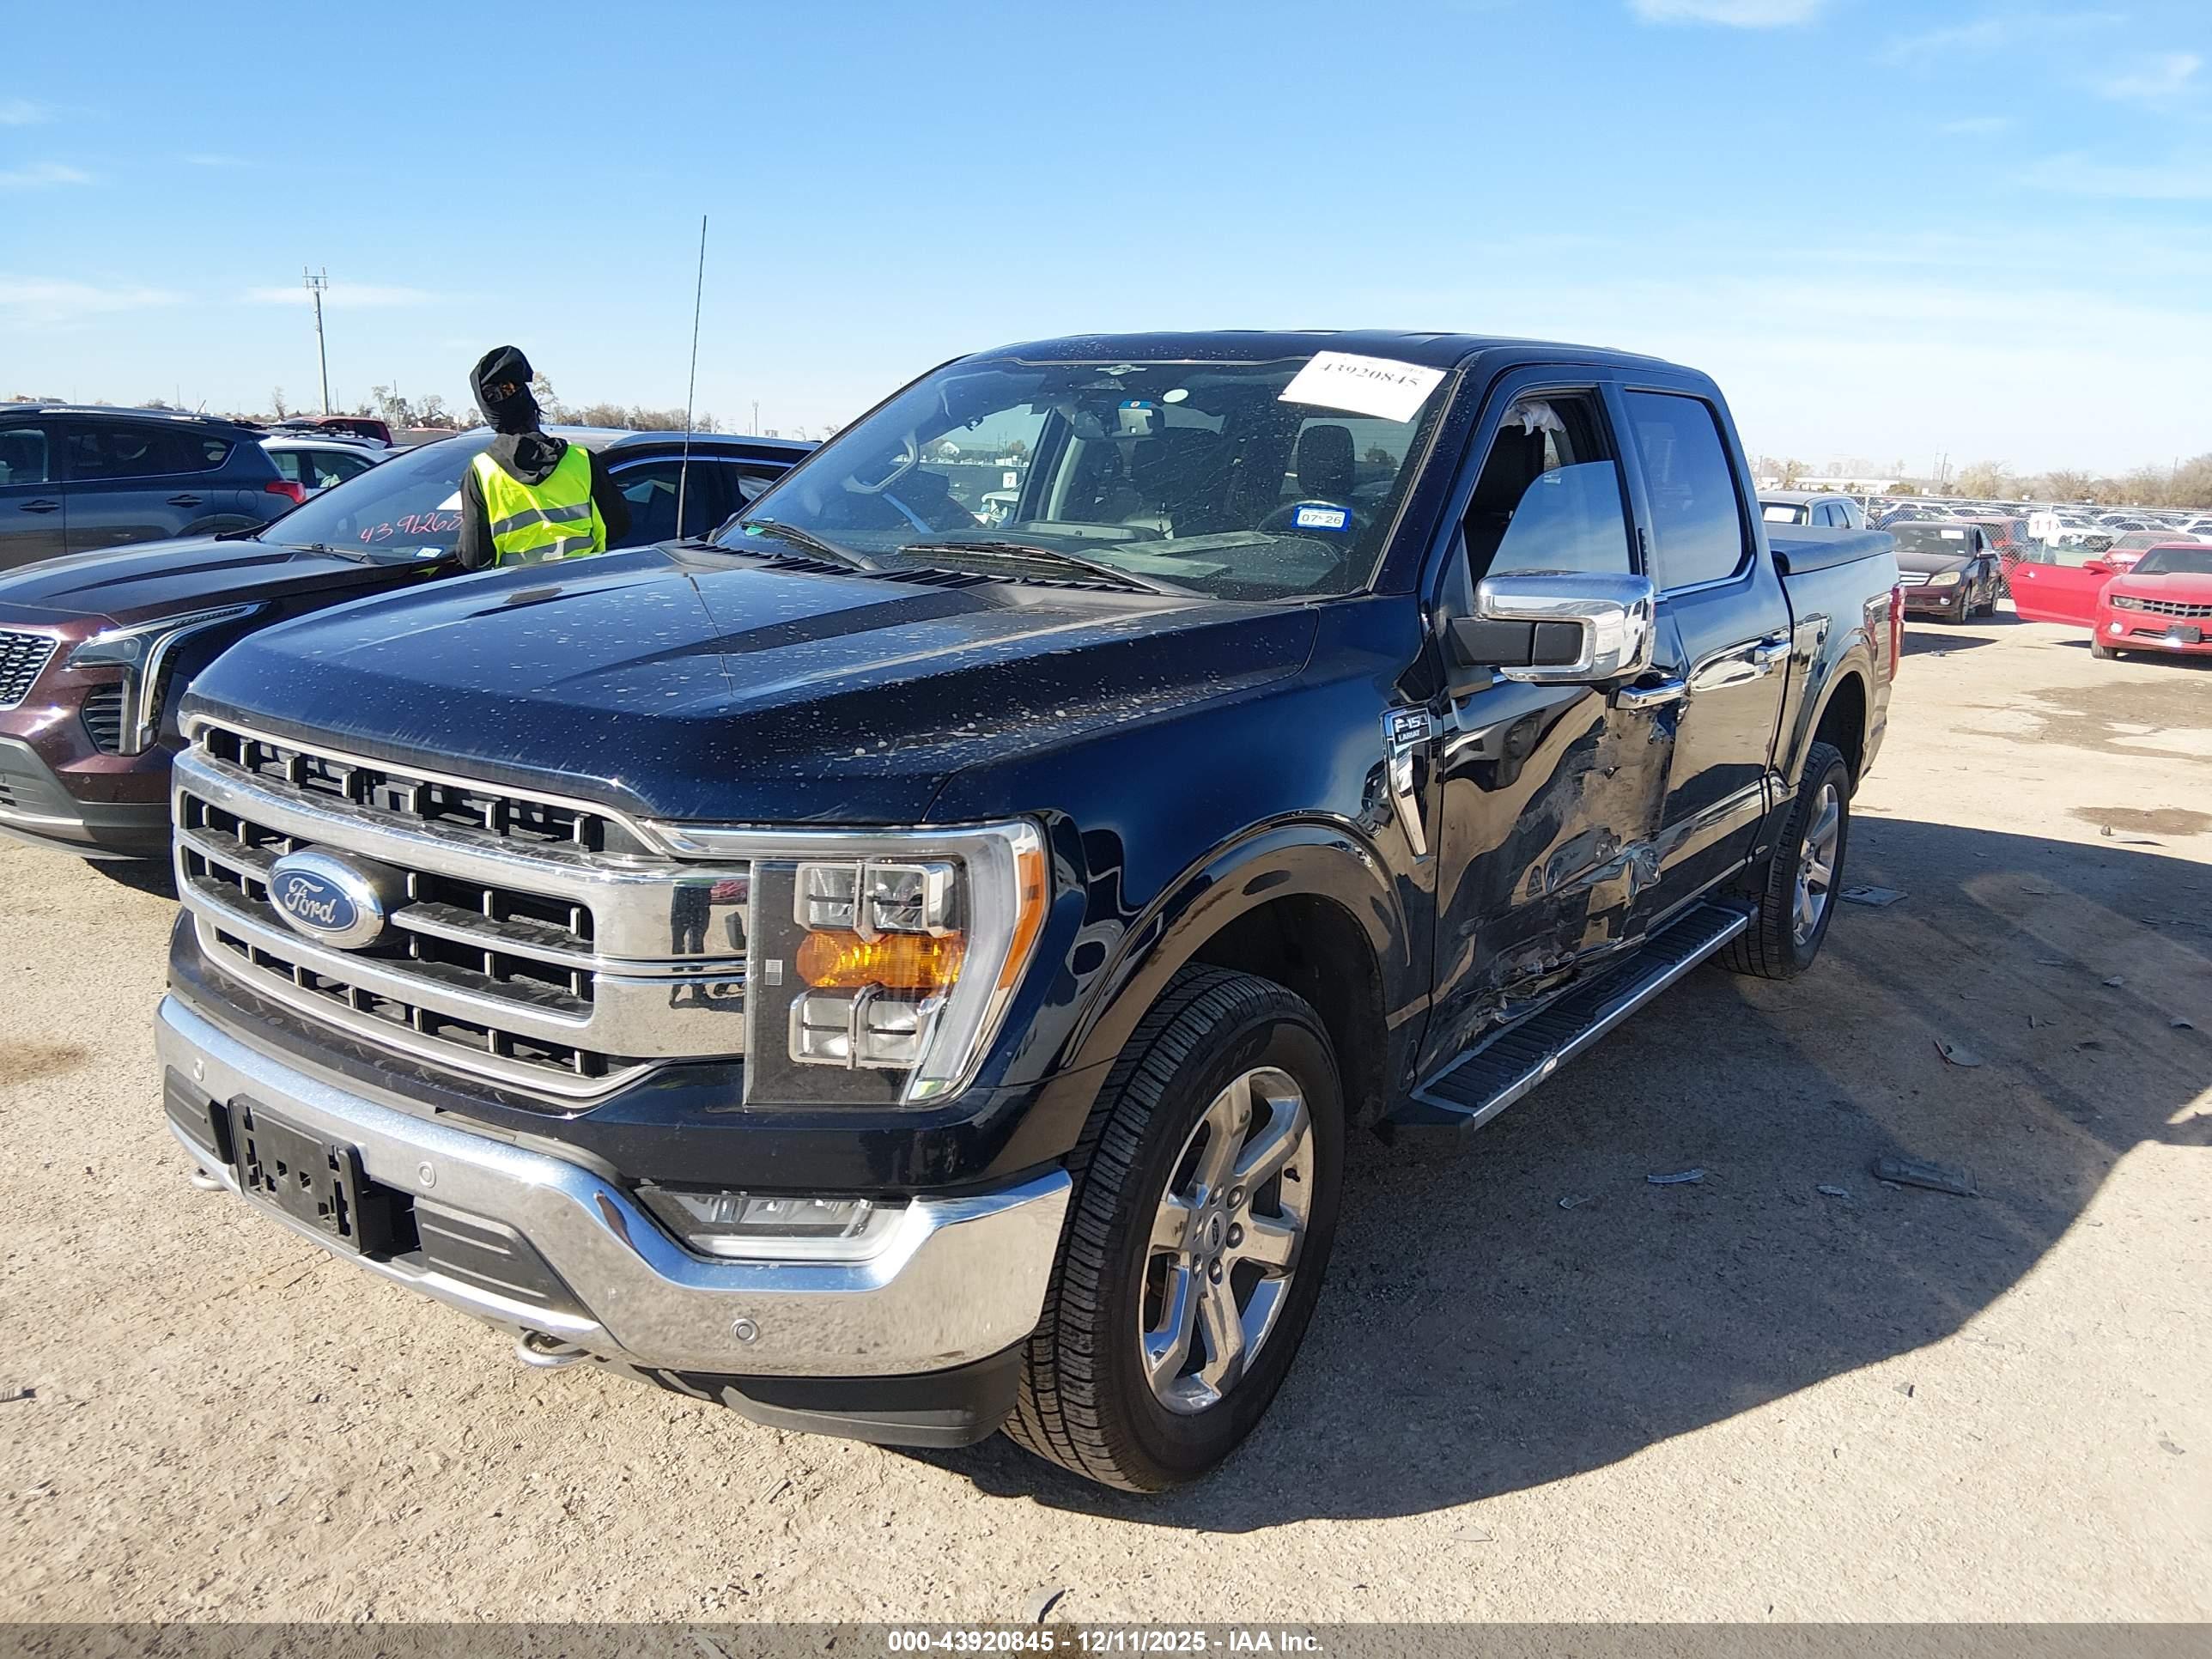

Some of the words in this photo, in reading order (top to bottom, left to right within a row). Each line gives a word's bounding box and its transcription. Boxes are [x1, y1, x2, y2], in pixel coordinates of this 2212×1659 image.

[1320, 362, 1422, 386] 43920845
[1007, 476, 1013, 485] 7
[1398, 729, 1420, 742] LARIAT
[284, 877, 337, 924] Ford
